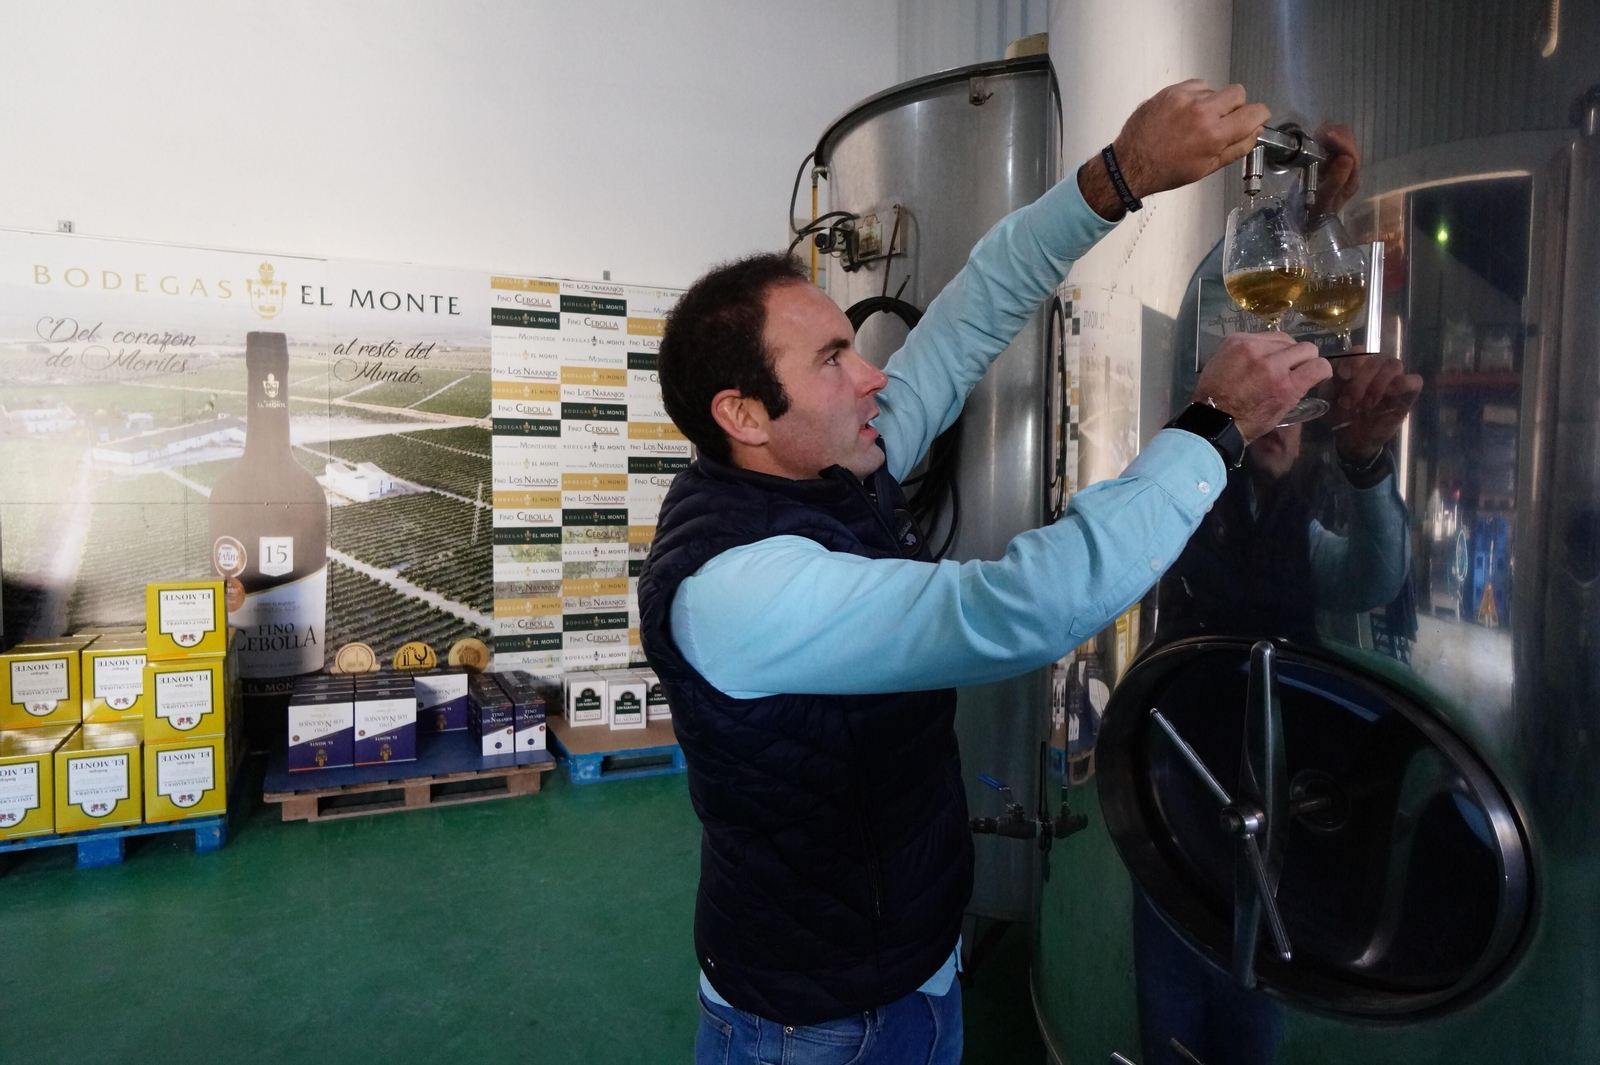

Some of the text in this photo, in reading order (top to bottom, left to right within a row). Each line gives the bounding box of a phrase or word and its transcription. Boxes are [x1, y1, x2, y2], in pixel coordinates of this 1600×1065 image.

[34, 264, 461, 315] BODEGAS EL MONTE
[36, 317, 196, 350] Del corazón
[333, 338, 436, 360] al resto del
[46, 351, 75, 367] de
[333, 359, 424, 385] Mundo.
[266, 545, 287, 563] 15
[259, 623, 294, 635] FINO
[236, 625, 317, 651] CEBOLLA
[266, 682, 293, 691] MON
[299, 720, 332, 728] NARANJOS
[364, 715, 396, 723] NARANJOS
[72, 761, 109, 770] MONTE
[161, 754, 195, 762] MONTE
